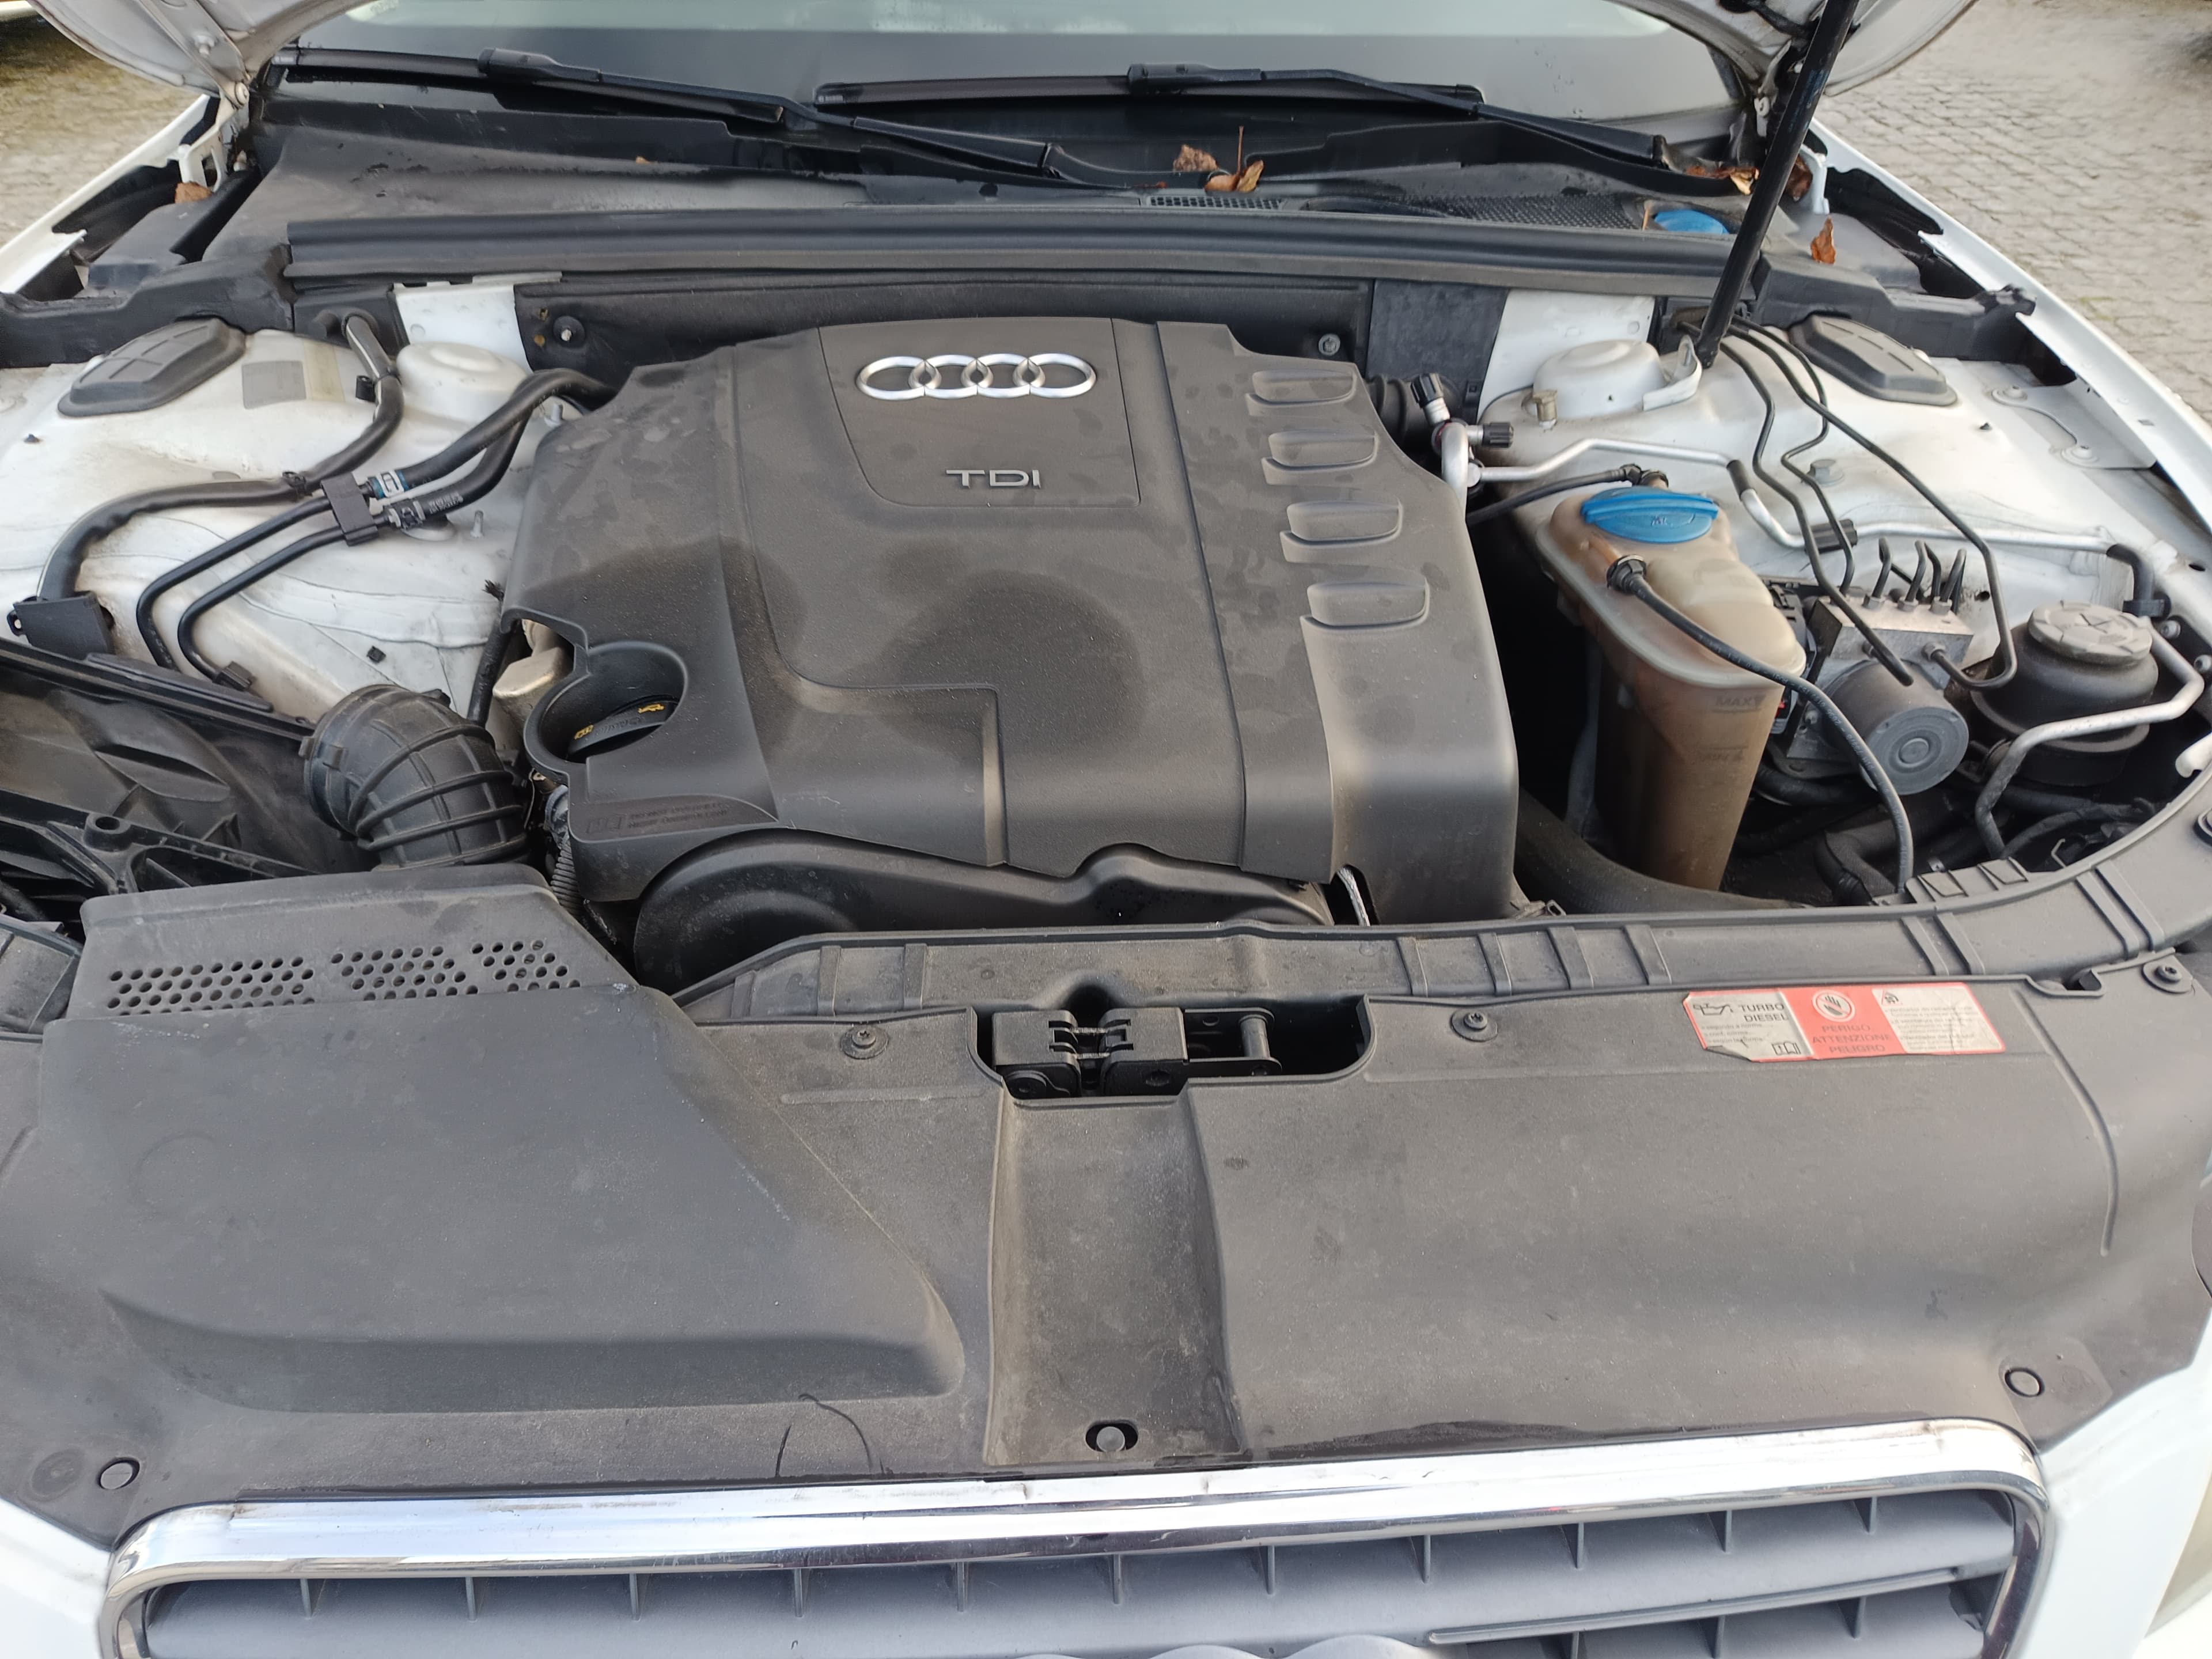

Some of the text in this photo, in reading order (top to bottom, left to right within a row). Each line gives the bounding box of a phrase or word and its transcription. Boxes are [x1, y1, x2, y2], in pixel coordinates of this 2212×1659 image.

[946, 469, 1040, 488] TDI
[1738, 1003, 1785, 1013] TURBO
[1744, 1013, 1789, 1022] DIESEL
[1822, 1024, 1871, 1033] PERIGO
[1813, 1034, 1890, 1044] ATTENZIONE
[1829, 1044, 1885, 1054] PELIGRO
